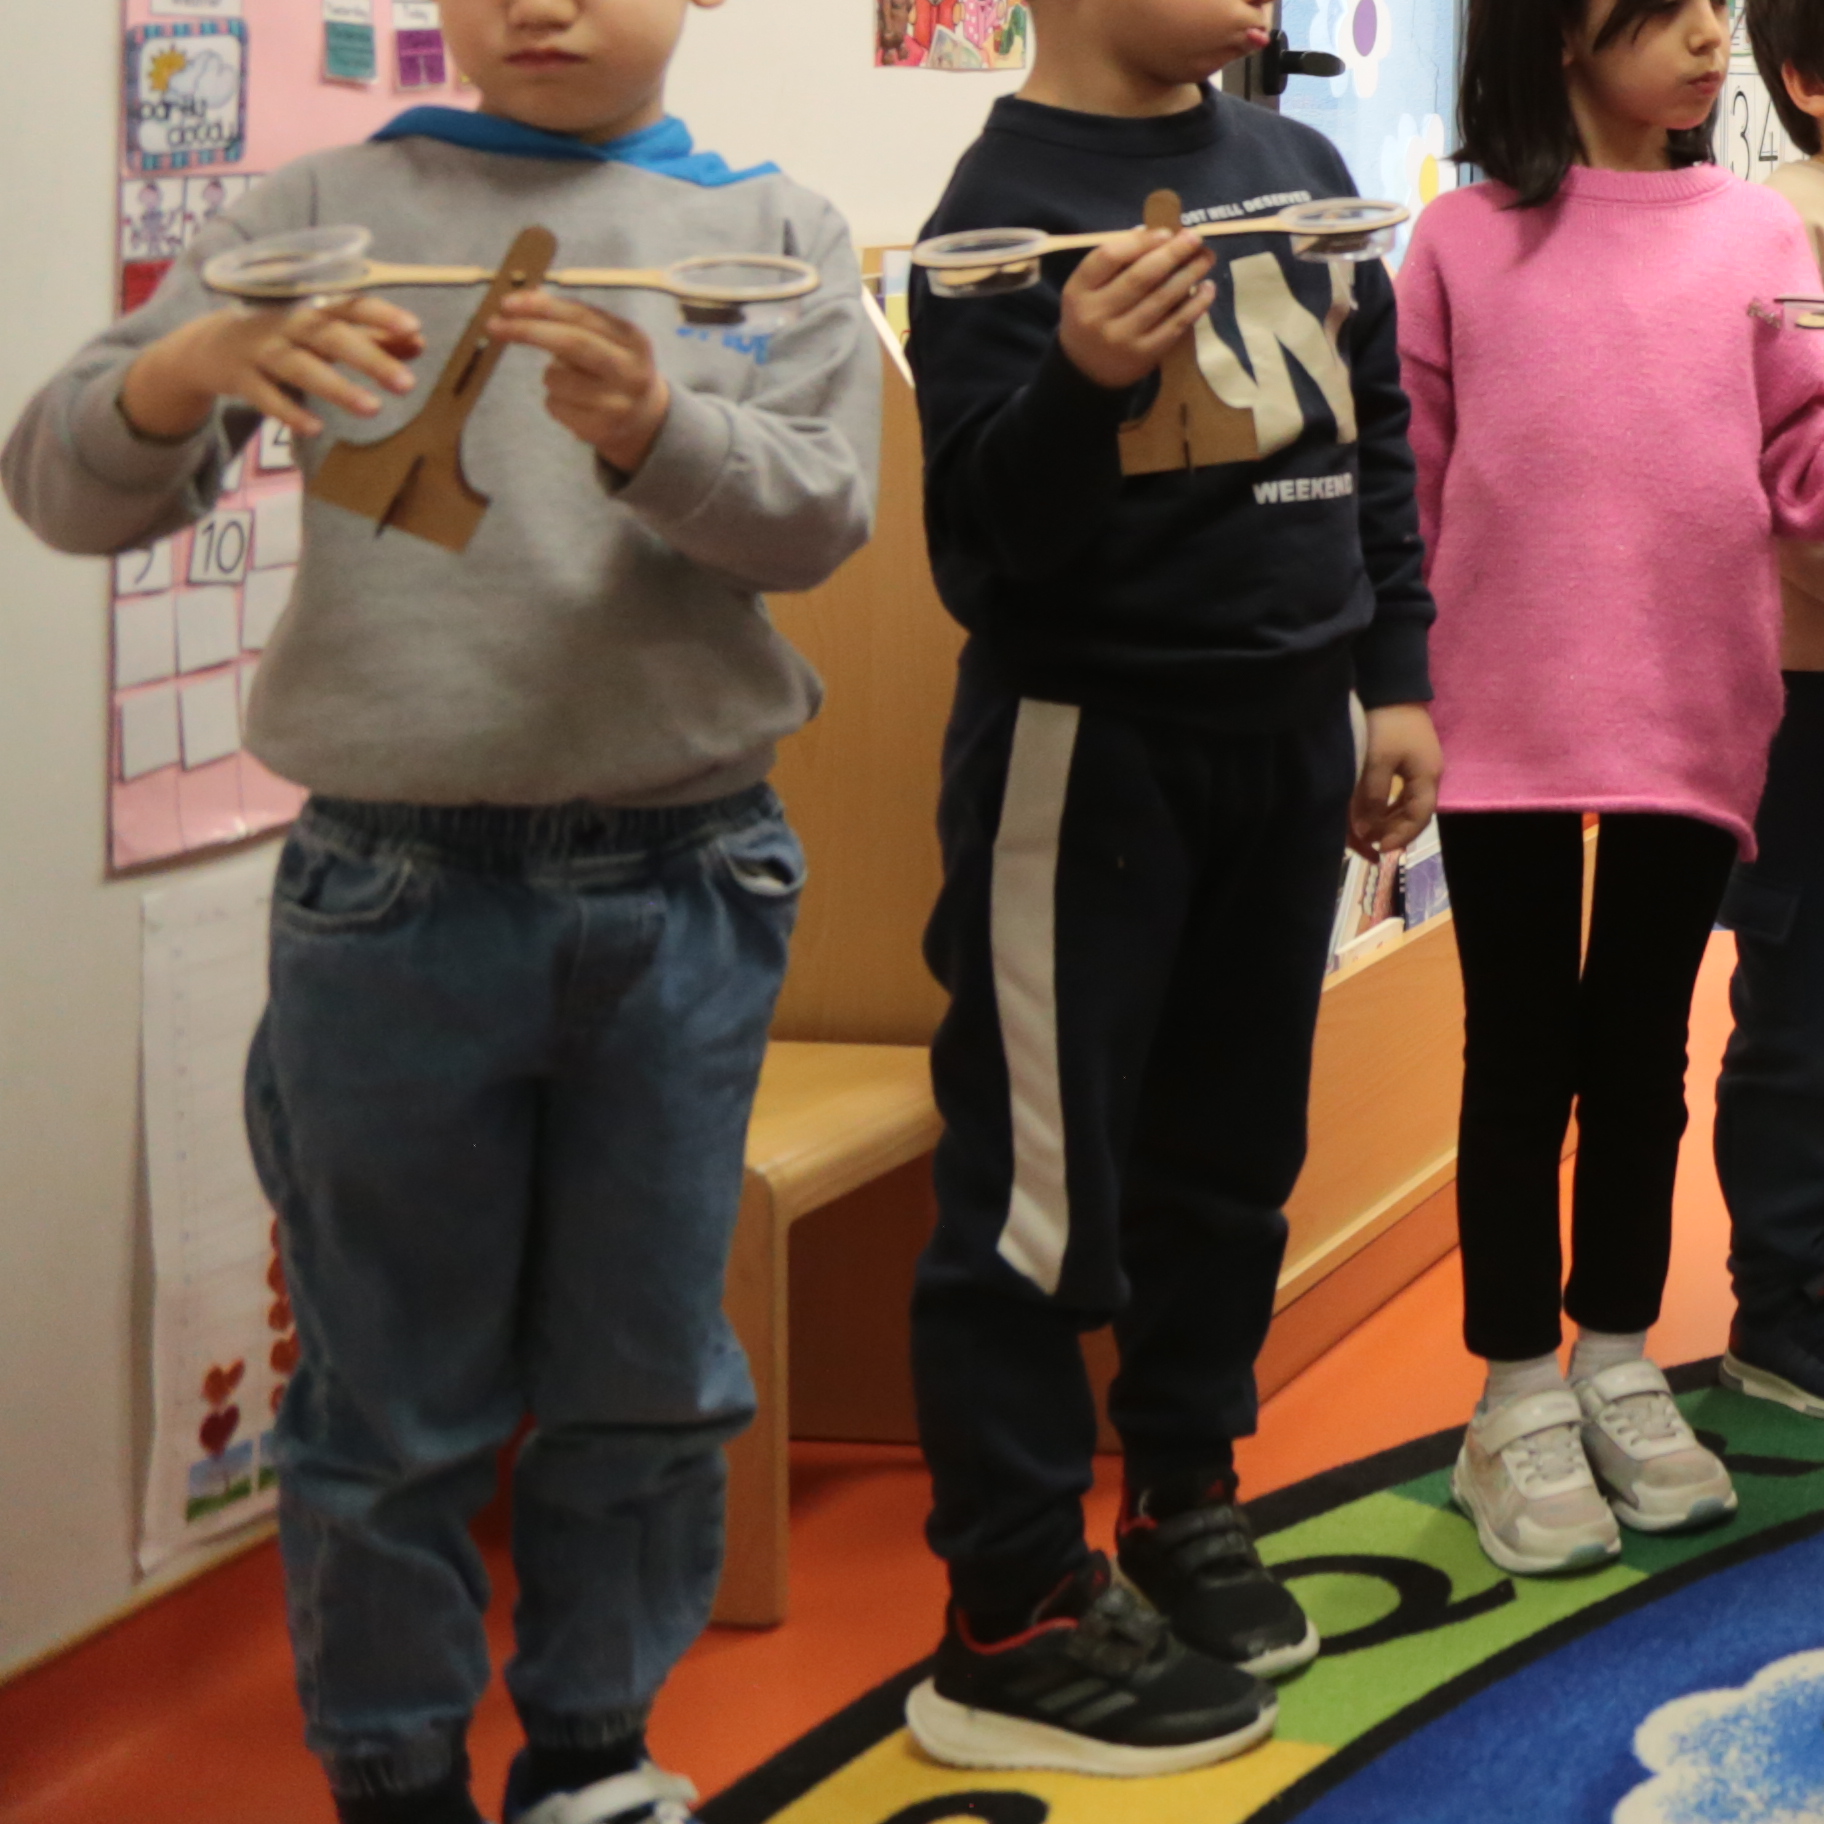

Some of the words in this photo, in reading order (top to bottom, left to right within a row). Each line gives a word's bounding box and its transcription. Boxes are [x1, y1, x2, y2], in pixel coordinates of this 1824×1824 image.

[1179, 206, 1207, 227] OST
[1209, 198, 1244, 221] WELL
[1252, 473, 1354, 505] WEEKEND
[202, 520, 245, 574] 10
